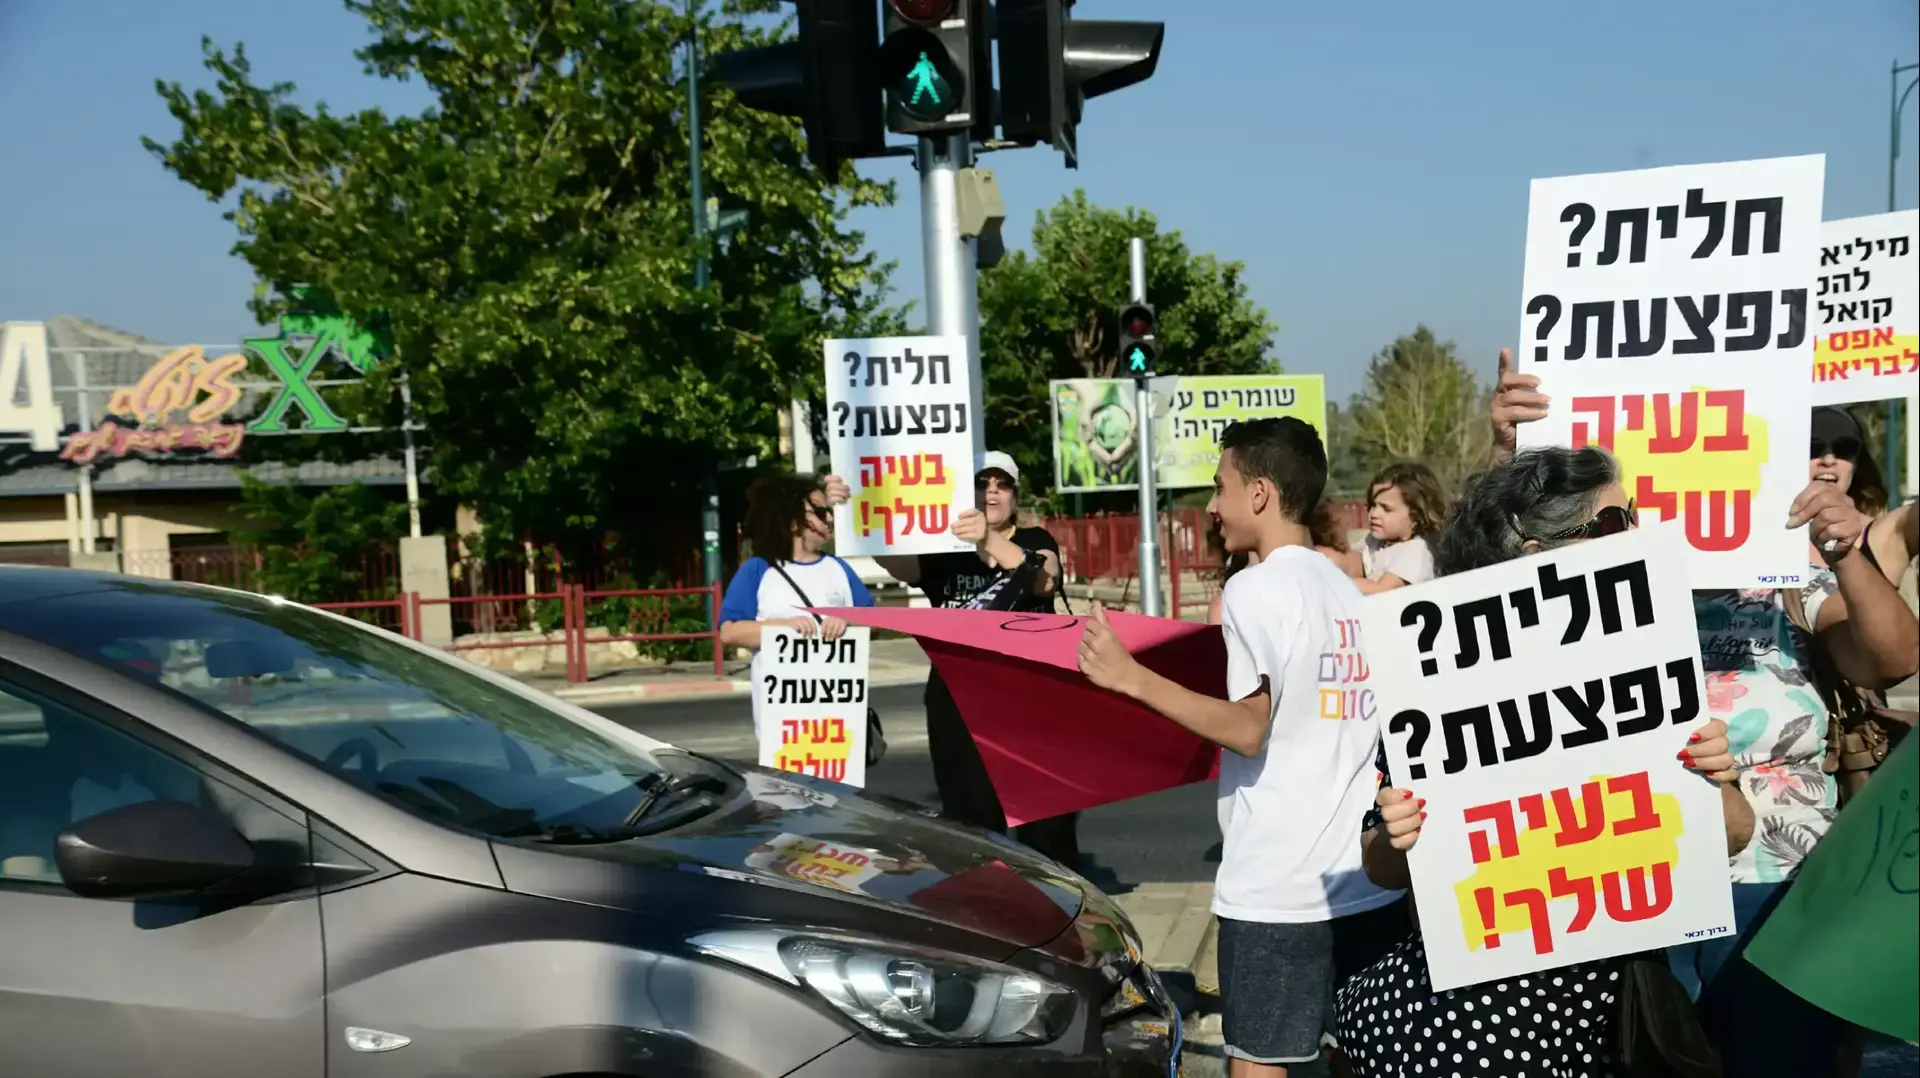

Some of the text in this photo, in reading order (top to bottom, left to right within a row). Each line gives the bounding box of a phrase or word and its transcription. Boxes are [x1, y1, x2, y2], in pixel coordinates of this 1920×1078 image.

[1559, 187, 1784, 268] חלית?
[1819, 235, 1910, 268] מיליא
[1816, 266, 1871, 297] להנ
[1526, 288, 1808, 362] נפצעת?
[1817, 297, 1893, 324] קואל
[1828, 326, 1896, 352] אפס
[843, 348, 951, 386] חלית?
[1811, 347, 1919, 384] לבריאו
[1202, 387, 1296, 410] שומרים
[832, 401, 967, 438] נפצעת?
[1174, 416, 1234, 444] קיה!
[1572, 389, 1748, 454] בעיה
[860, 452, 946, 488] בעיה
[860, 498, 949, 546] שלך!
[1635, 476, 1751, 552] של
[1400, 558, 1655, 677] חלית?
[775, 633, 856, 664] חלית?
[1700, 635, 1776, 652] alifornia
[763, 674, 866, 705] נפצעת?
[781, 718, 846, 745] בעיה
[1389, 656, 1700, 780] נפצעת?
[1463, 770, 1661, 864] בעיה
[1475, 861, 1674, 955] שלך!
